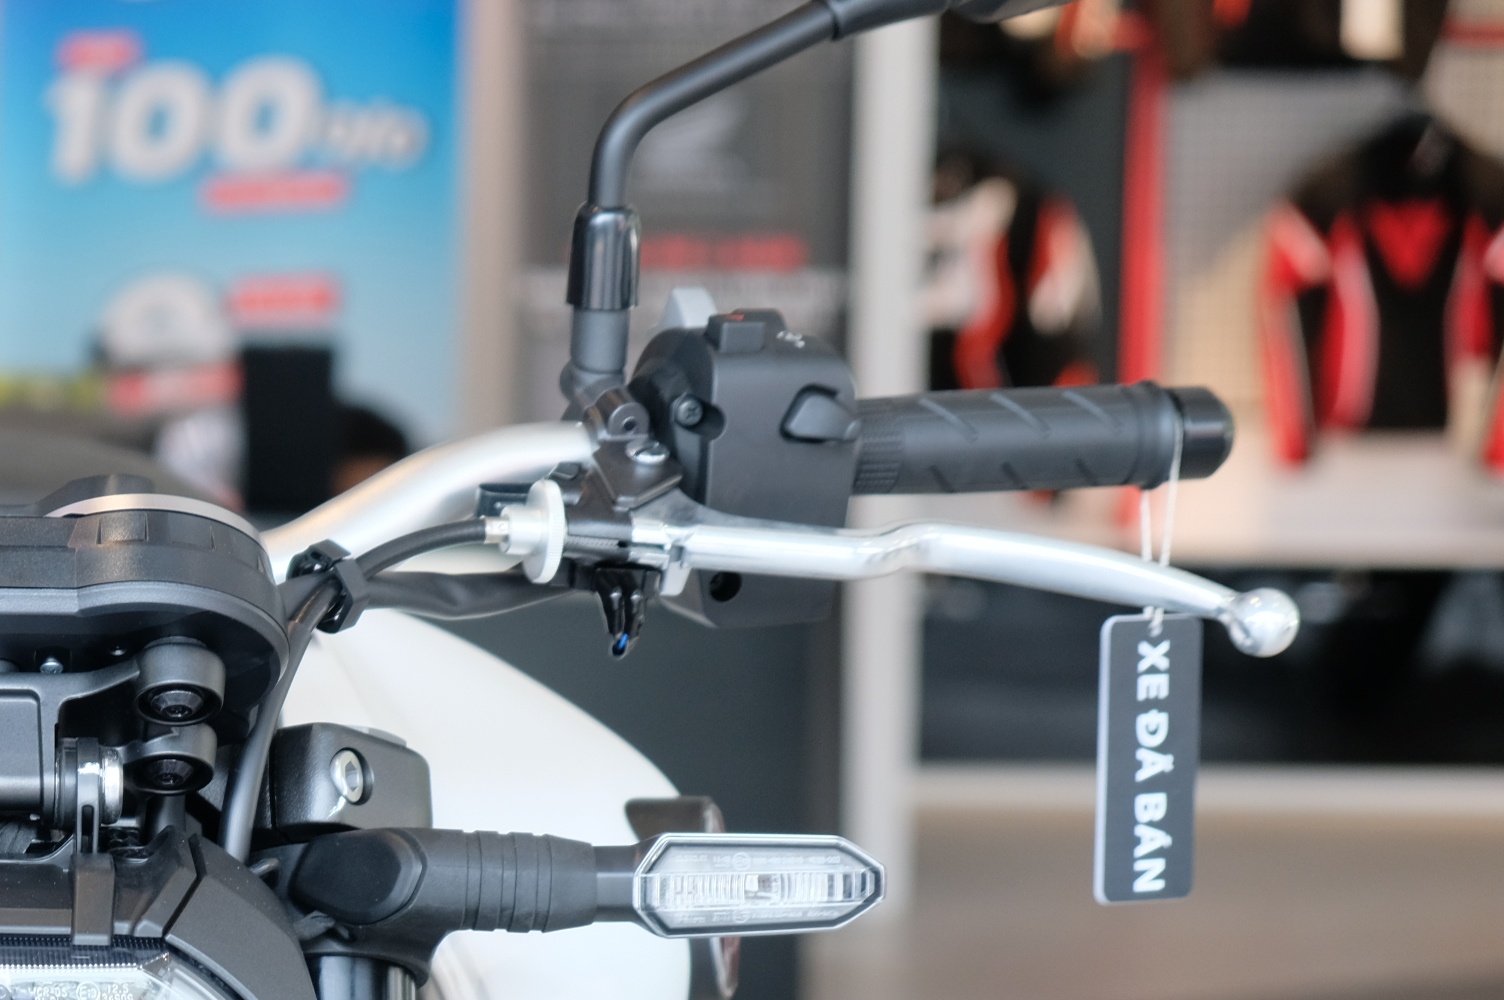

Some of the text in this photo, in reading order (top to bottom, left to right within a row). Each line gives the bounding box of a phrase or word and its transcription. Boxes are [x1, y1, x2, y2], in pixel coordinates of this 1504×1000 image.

[1132, 639, 1175, 893] XE ĐÃ BÁN
